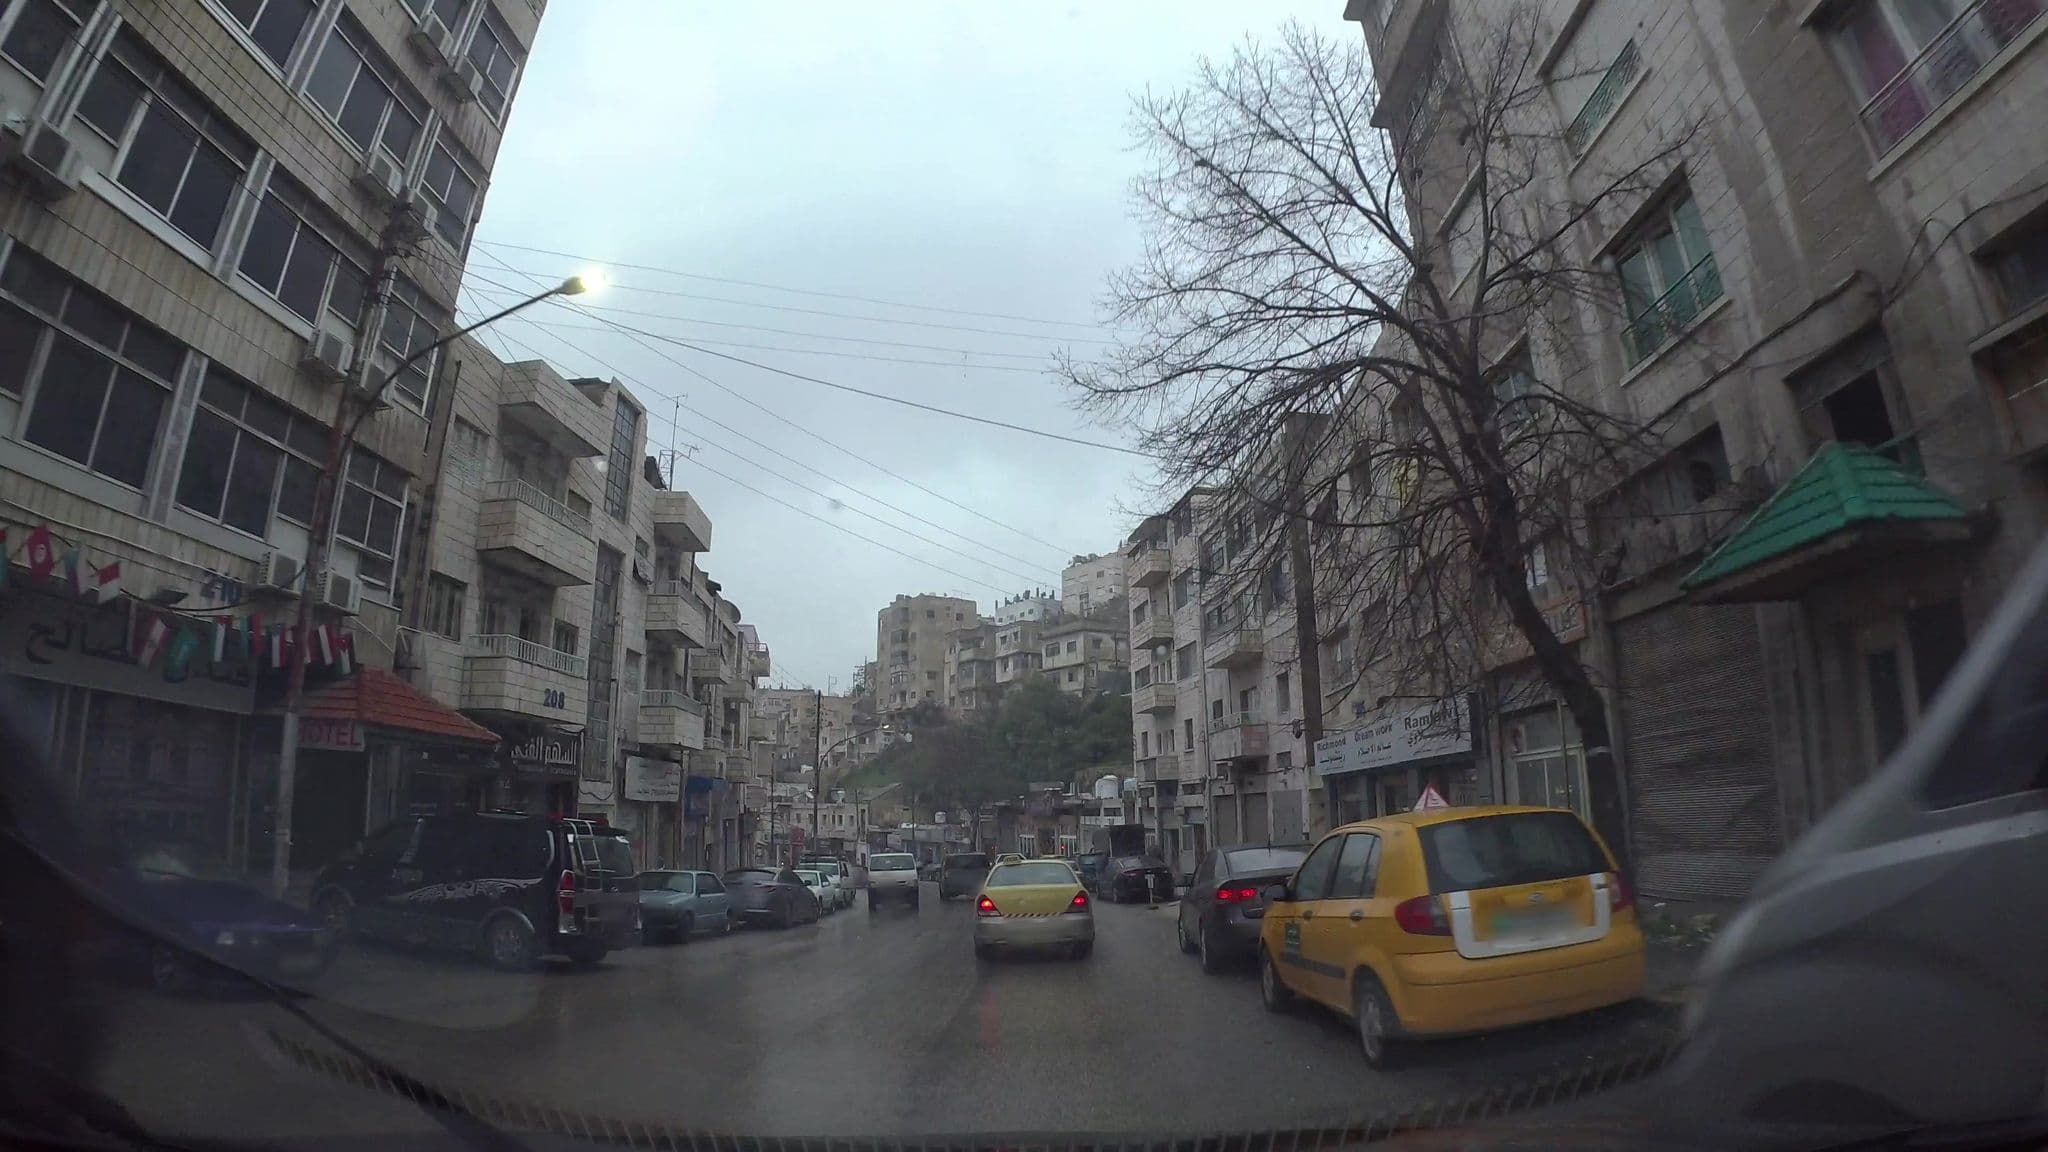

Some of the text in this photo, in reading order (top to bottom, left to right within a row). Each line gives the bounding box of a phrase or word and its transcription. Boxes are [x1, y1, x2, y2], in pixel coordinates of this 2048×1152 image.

[543, 688, 565, 710] 208
[511, 736, 577, 766] السهم الفني
